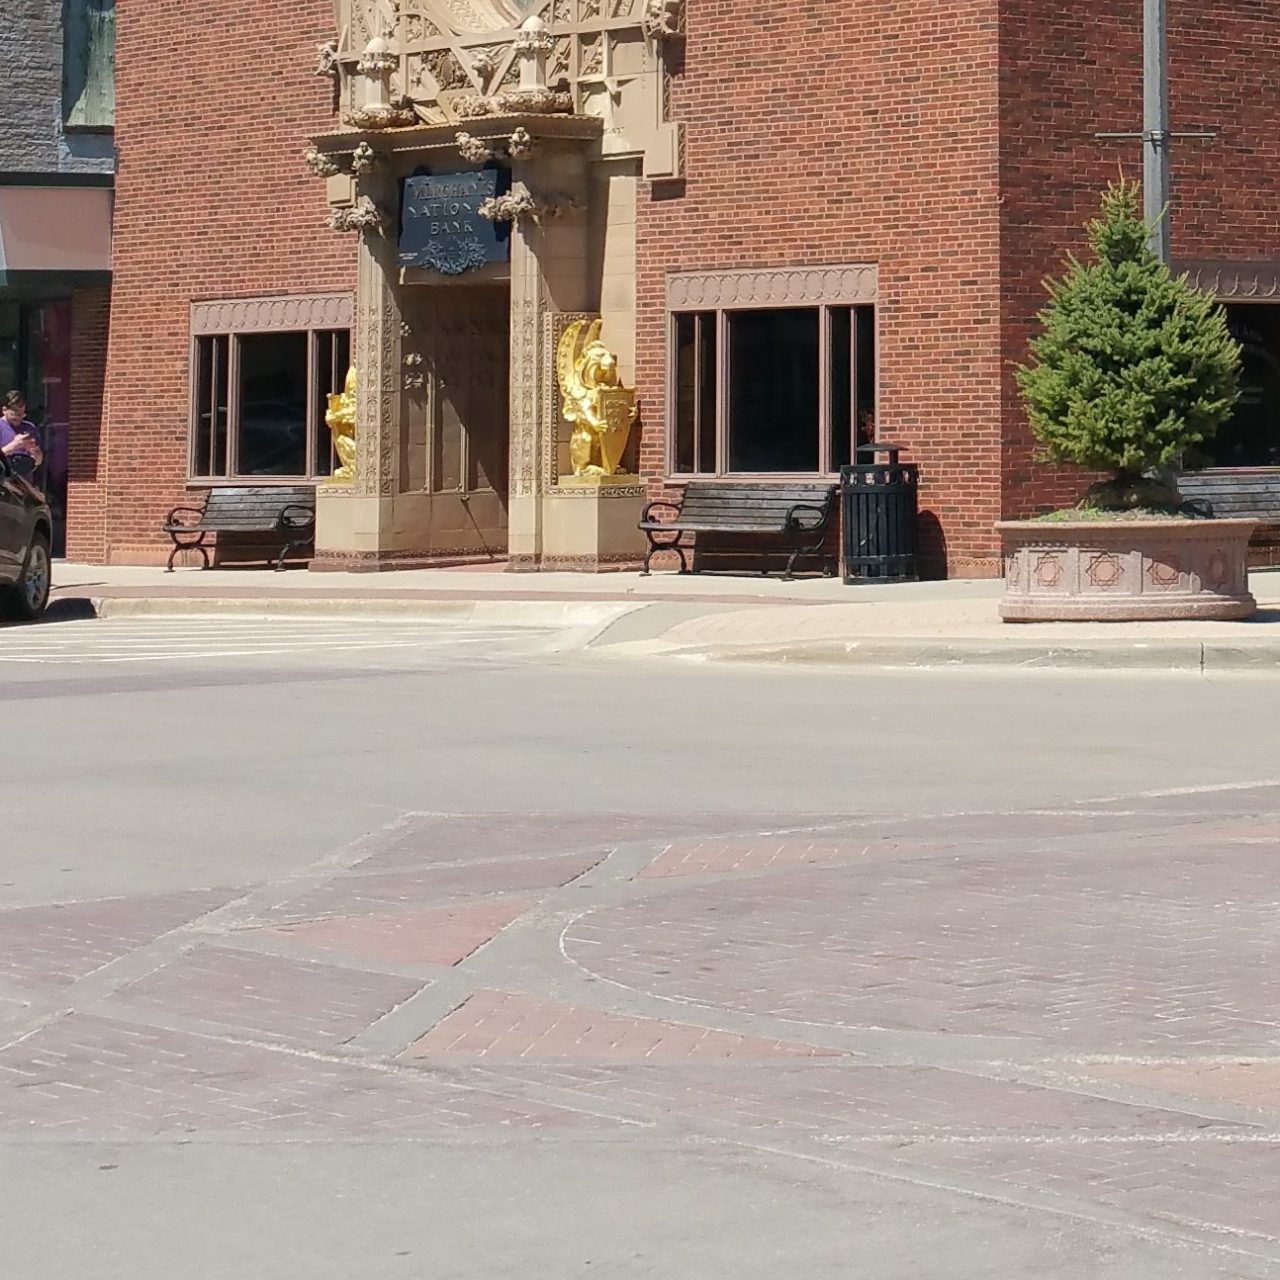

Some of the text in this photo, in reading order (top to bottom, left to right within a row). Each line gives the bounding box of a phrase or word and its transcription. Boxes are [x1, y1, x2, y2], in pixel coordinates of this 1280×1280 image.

[412, 180, 495, 200] MERCHANTS
[407, 202, 474, 218] NATION
[430, 220, 474, 235] BANK
